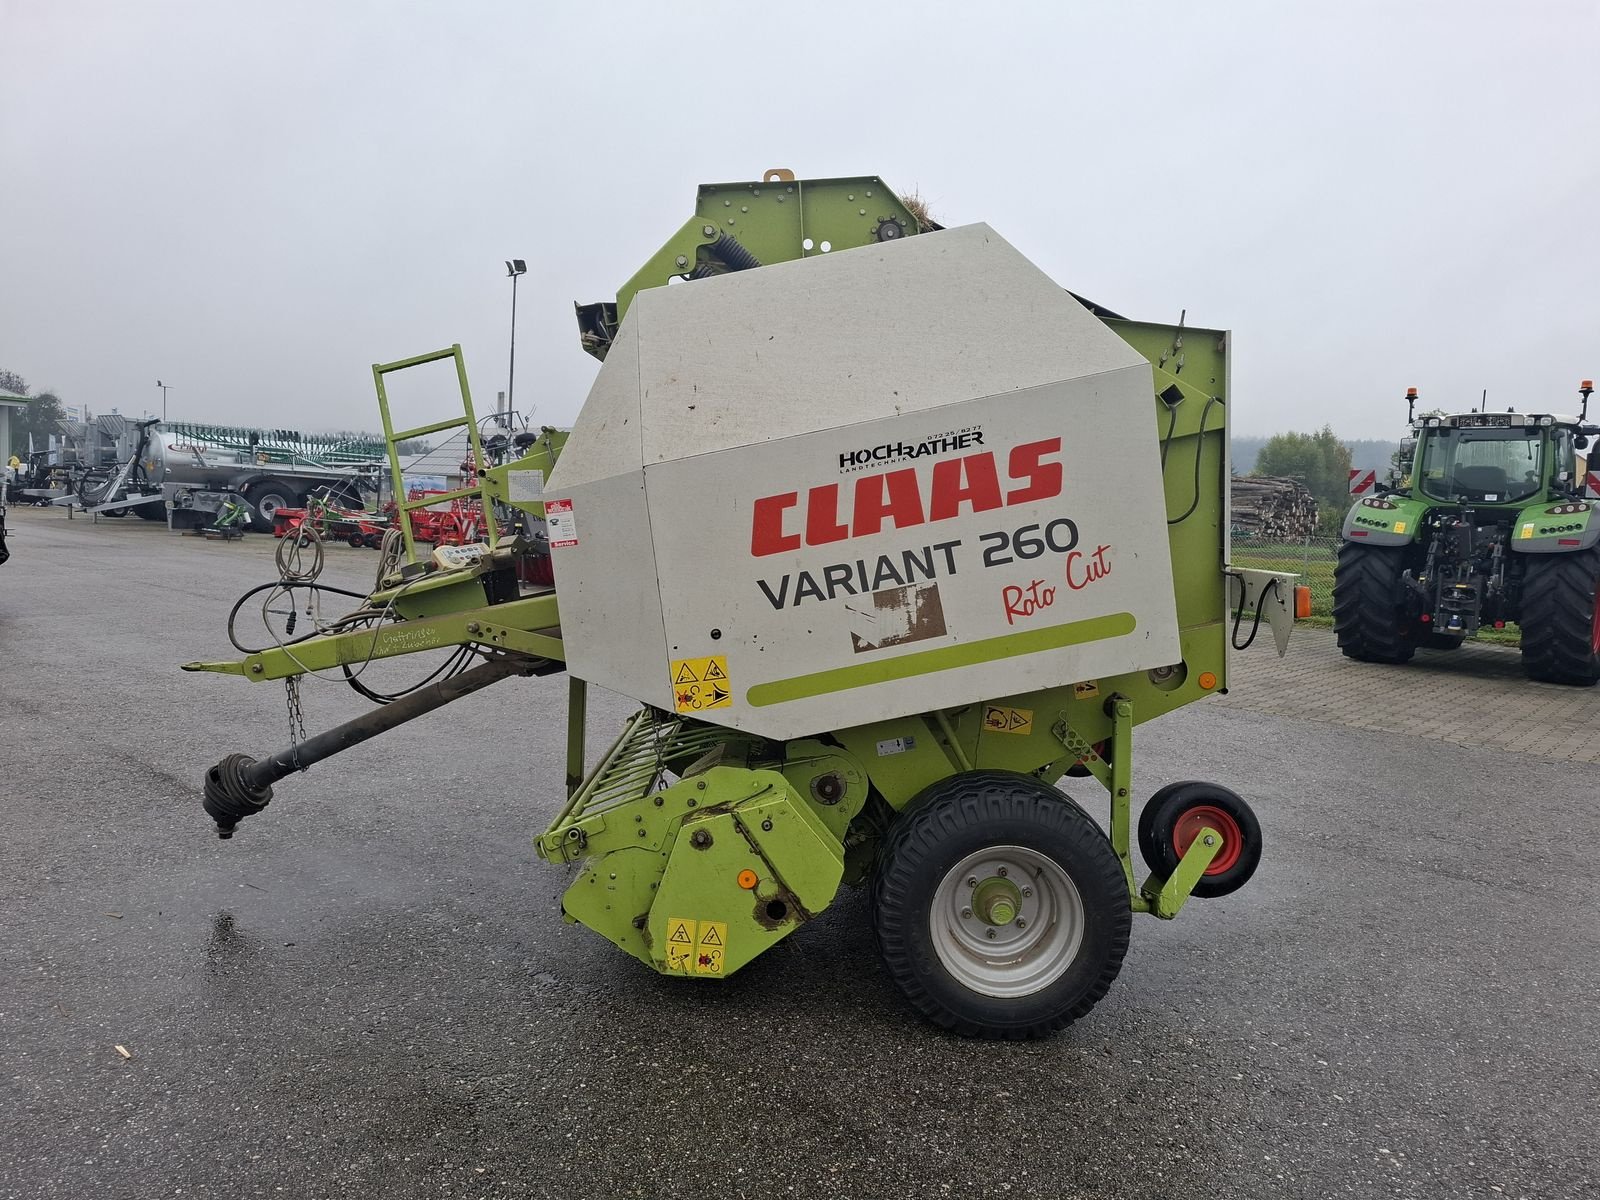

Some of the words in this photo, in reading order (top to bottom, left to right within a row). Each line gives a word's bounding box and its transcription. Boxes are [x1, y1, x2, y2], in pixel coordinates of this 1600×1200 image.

[839, 431, 985, 468] HOCHRATHER
[839, 457, 907, 474] LANDTECHNIK
[750, 437, 1063, 557] CLAAS
[554, 540, 576, 548] Service
[756, 539, 962, 611] VARIANT
[979, 518, 1079, 568] 260
[1002, 579, 1056, 626] Roto
[1066, 544, 1111, 590] Cut
